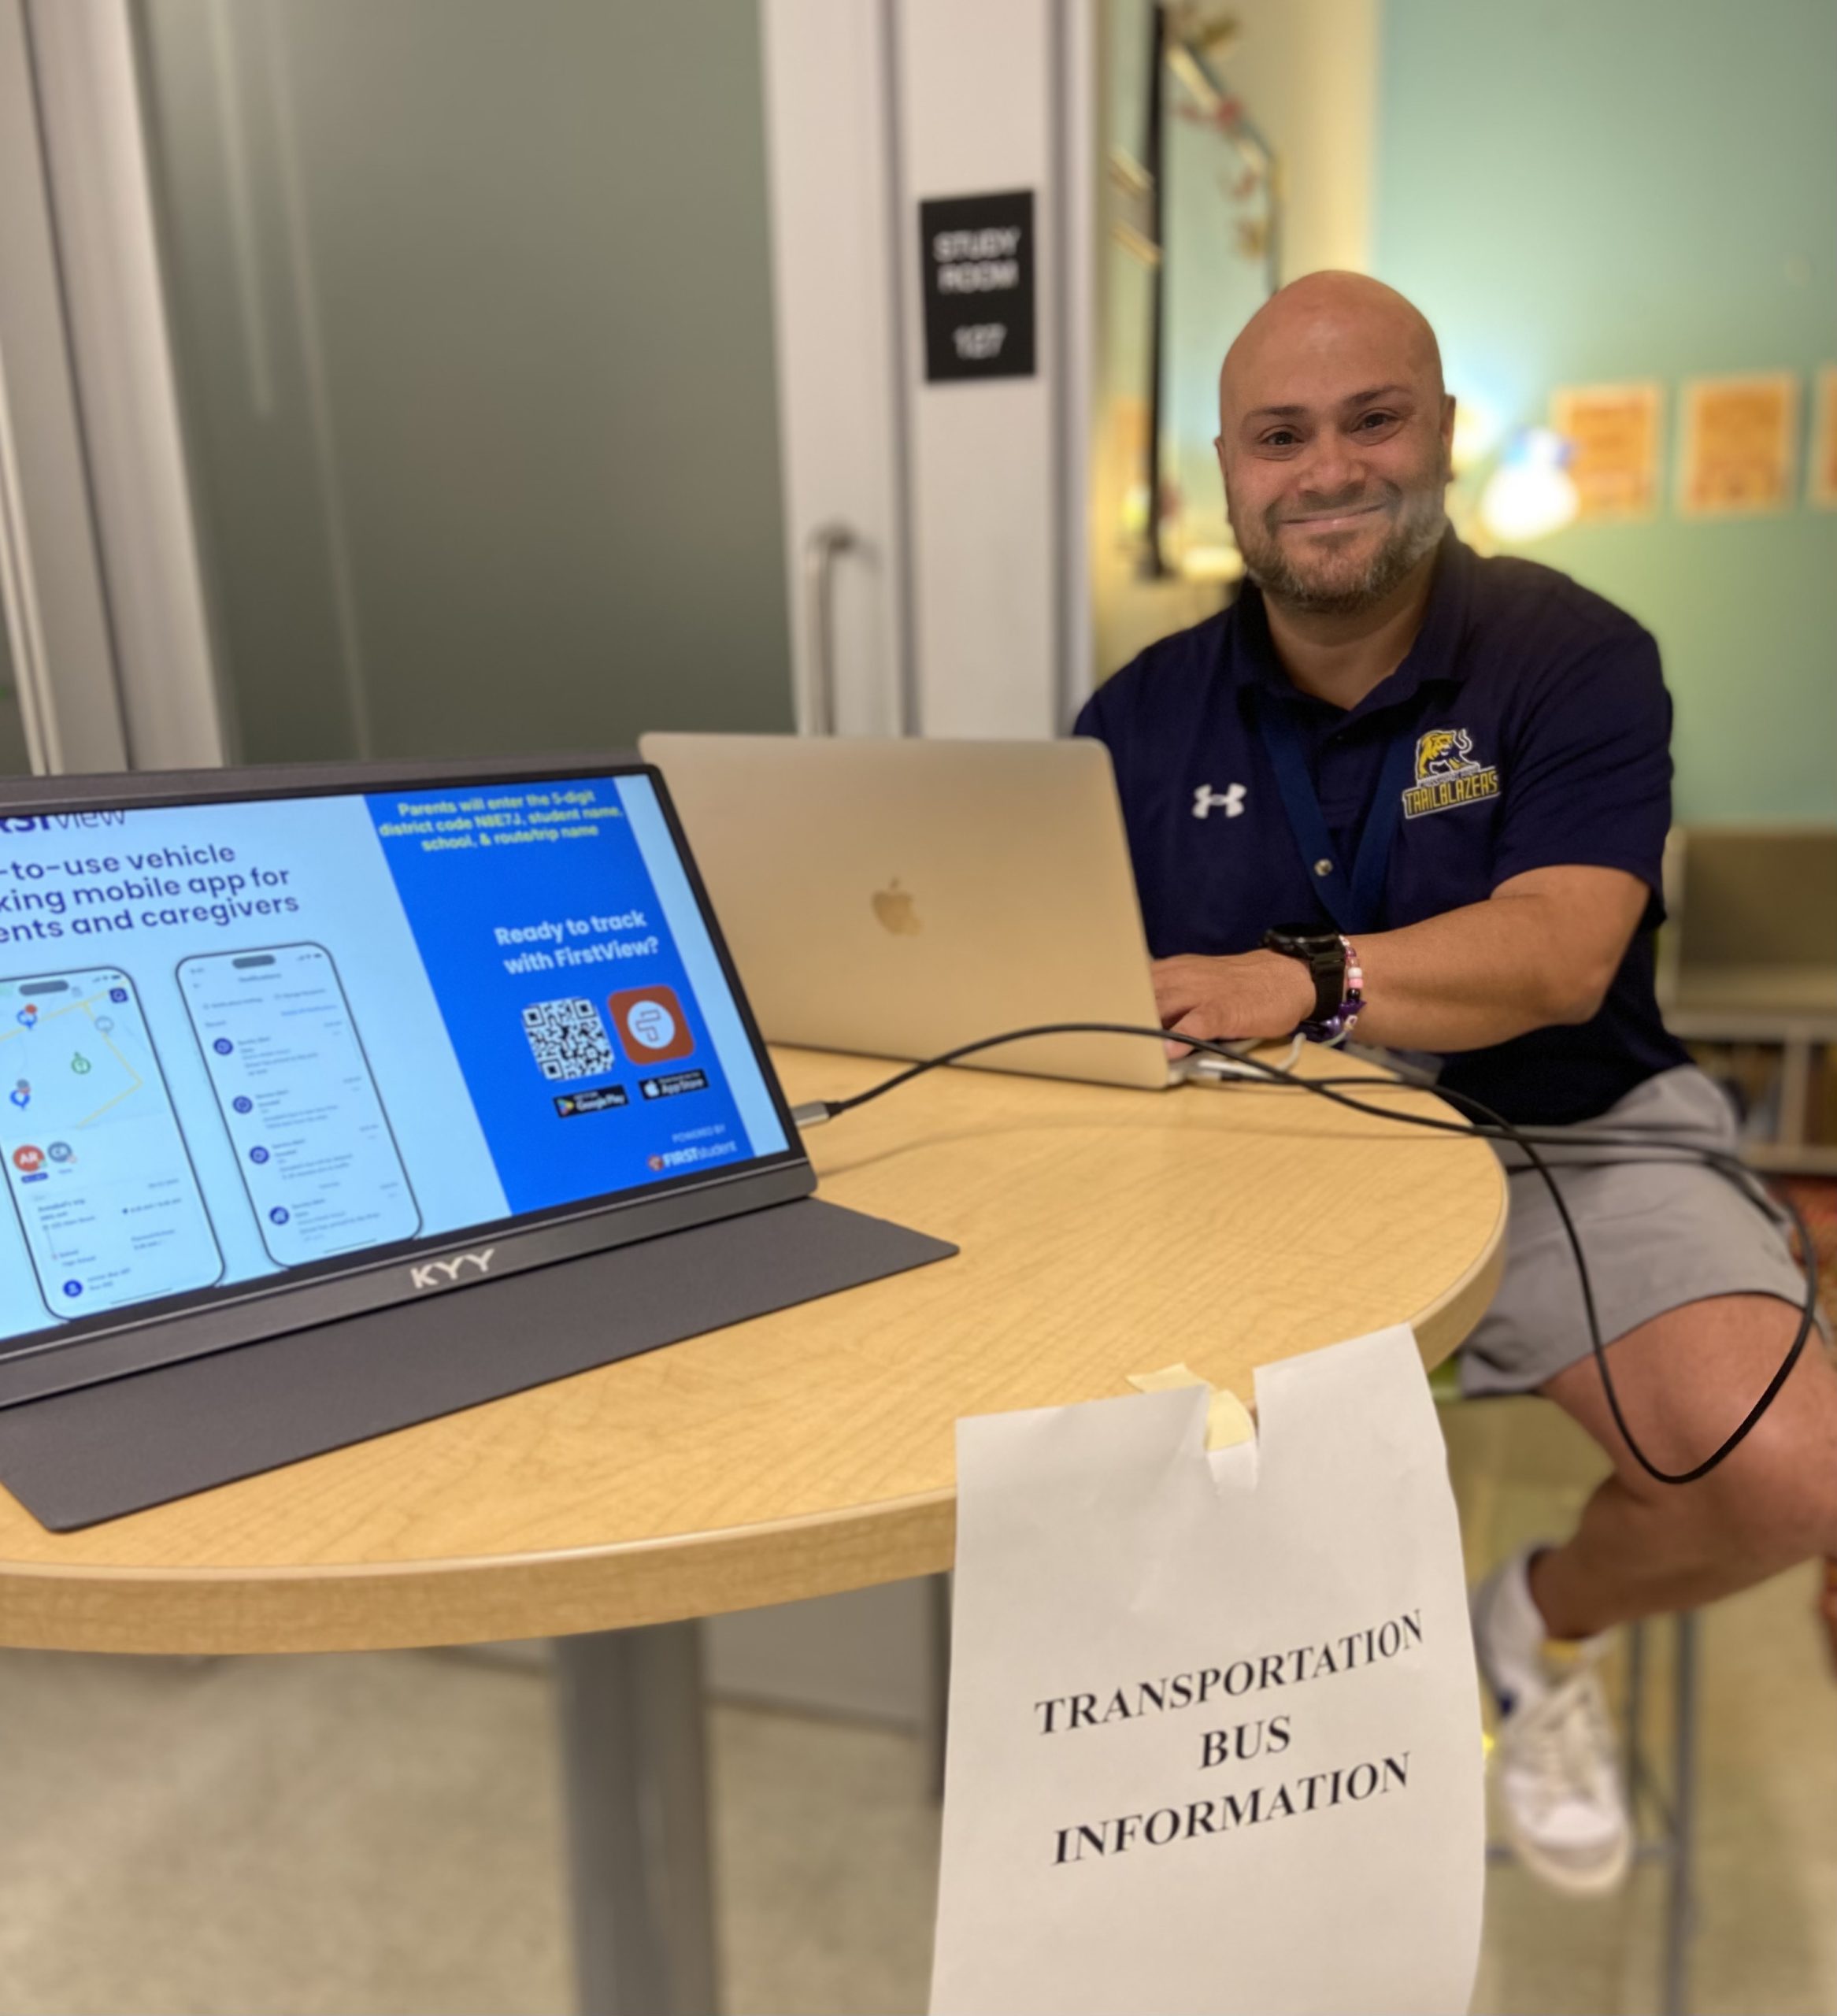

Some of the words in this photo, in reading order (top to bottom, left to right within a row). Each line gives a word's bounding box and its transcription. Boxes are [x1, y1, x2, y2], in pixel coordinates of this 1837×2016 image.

[933, 226, 1020, 262] STUDY
[937, 258, 1019, 294] ROOM
[398, 801, 457, 817] Parents
[459, 797, 486, 813] will
[487, 795, 524, 810] enter
[526, 793, 550, 806] the
[552, 790, 596, 806] 5-digit
[1406, 770, 1498, 814] TRAILBLAZERS
[380, 820, 432, 837] district
[436, 816, 472, 832] code
[528, 808, 580, 824] student
[480, 832, 491, 847] &
[561, 825, 598, 838] name
[127, 845, 235, 870] vehicle
[74, 878, 180, 905] mobile
[188, 873, 245, 899] app
[250, 867, 290, 888] for
[72, 910, 135, 936] and
[142, 895, 300, 926] caregivers
[494, 922, 564, 946] Ready
[566, 919, 590, 936] to
[591, 910, 647, 932] track
[504, 951, 554, 975] with
[554, 936, 659, 969] FirstView?
[410, 1248, 494, 1289] KYY
[1034, 1609, 1424, 1735] TRANSPORTATION
[1198, 1714, 1292, 1770] BUS
[1052, 1751, 1410, 1865] INFORMATION
